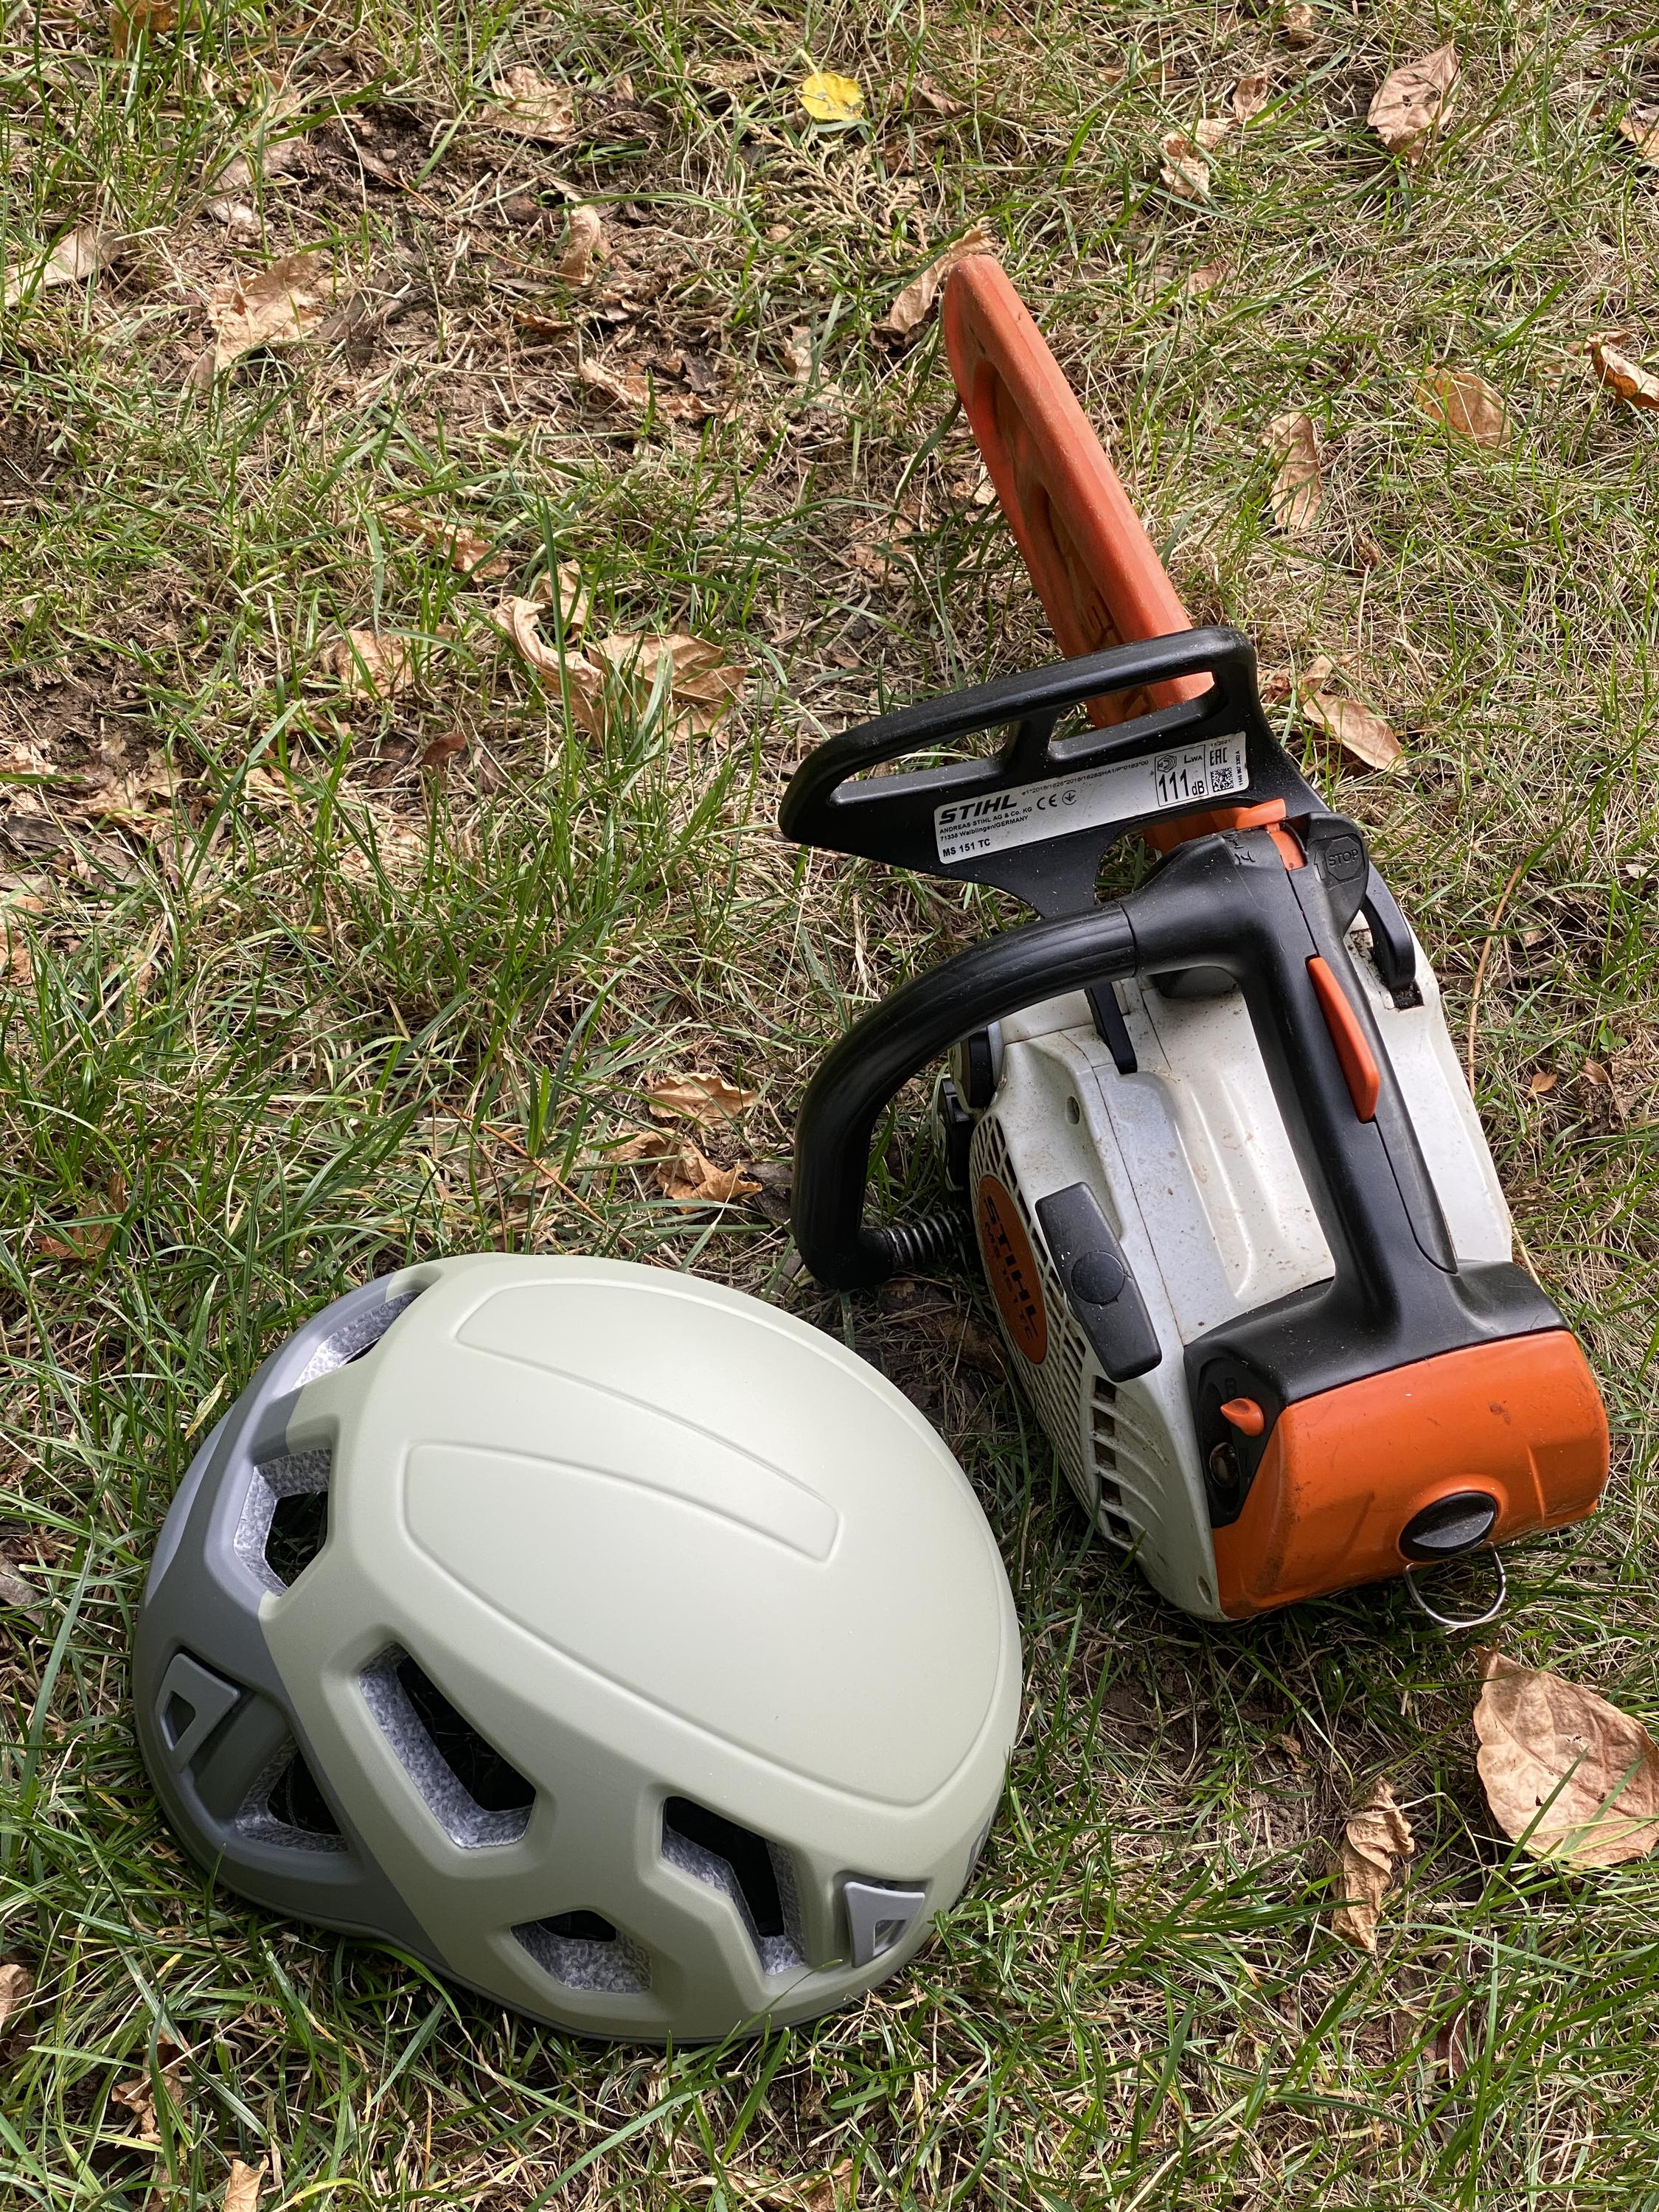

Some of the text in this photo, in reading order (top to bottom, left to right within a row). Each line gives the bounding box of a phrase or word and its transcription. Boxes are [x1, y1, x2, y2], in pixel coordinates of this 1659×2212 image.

[1158, 768, 1205, 802] 111 dB
[939, 794, 1017, 825] STIHL
[939, 821, 971, 834] ANDREAS
[973, 817, 992, 826] STIHL
[940, 815, 1029, 841] 71338 Waiblingen/GERMANY
[942, 838, 990, 858] MS 151 TC
[1329, 848, 1359, 867] STOP
[983, 1194, 1039, 1338] STIHL
